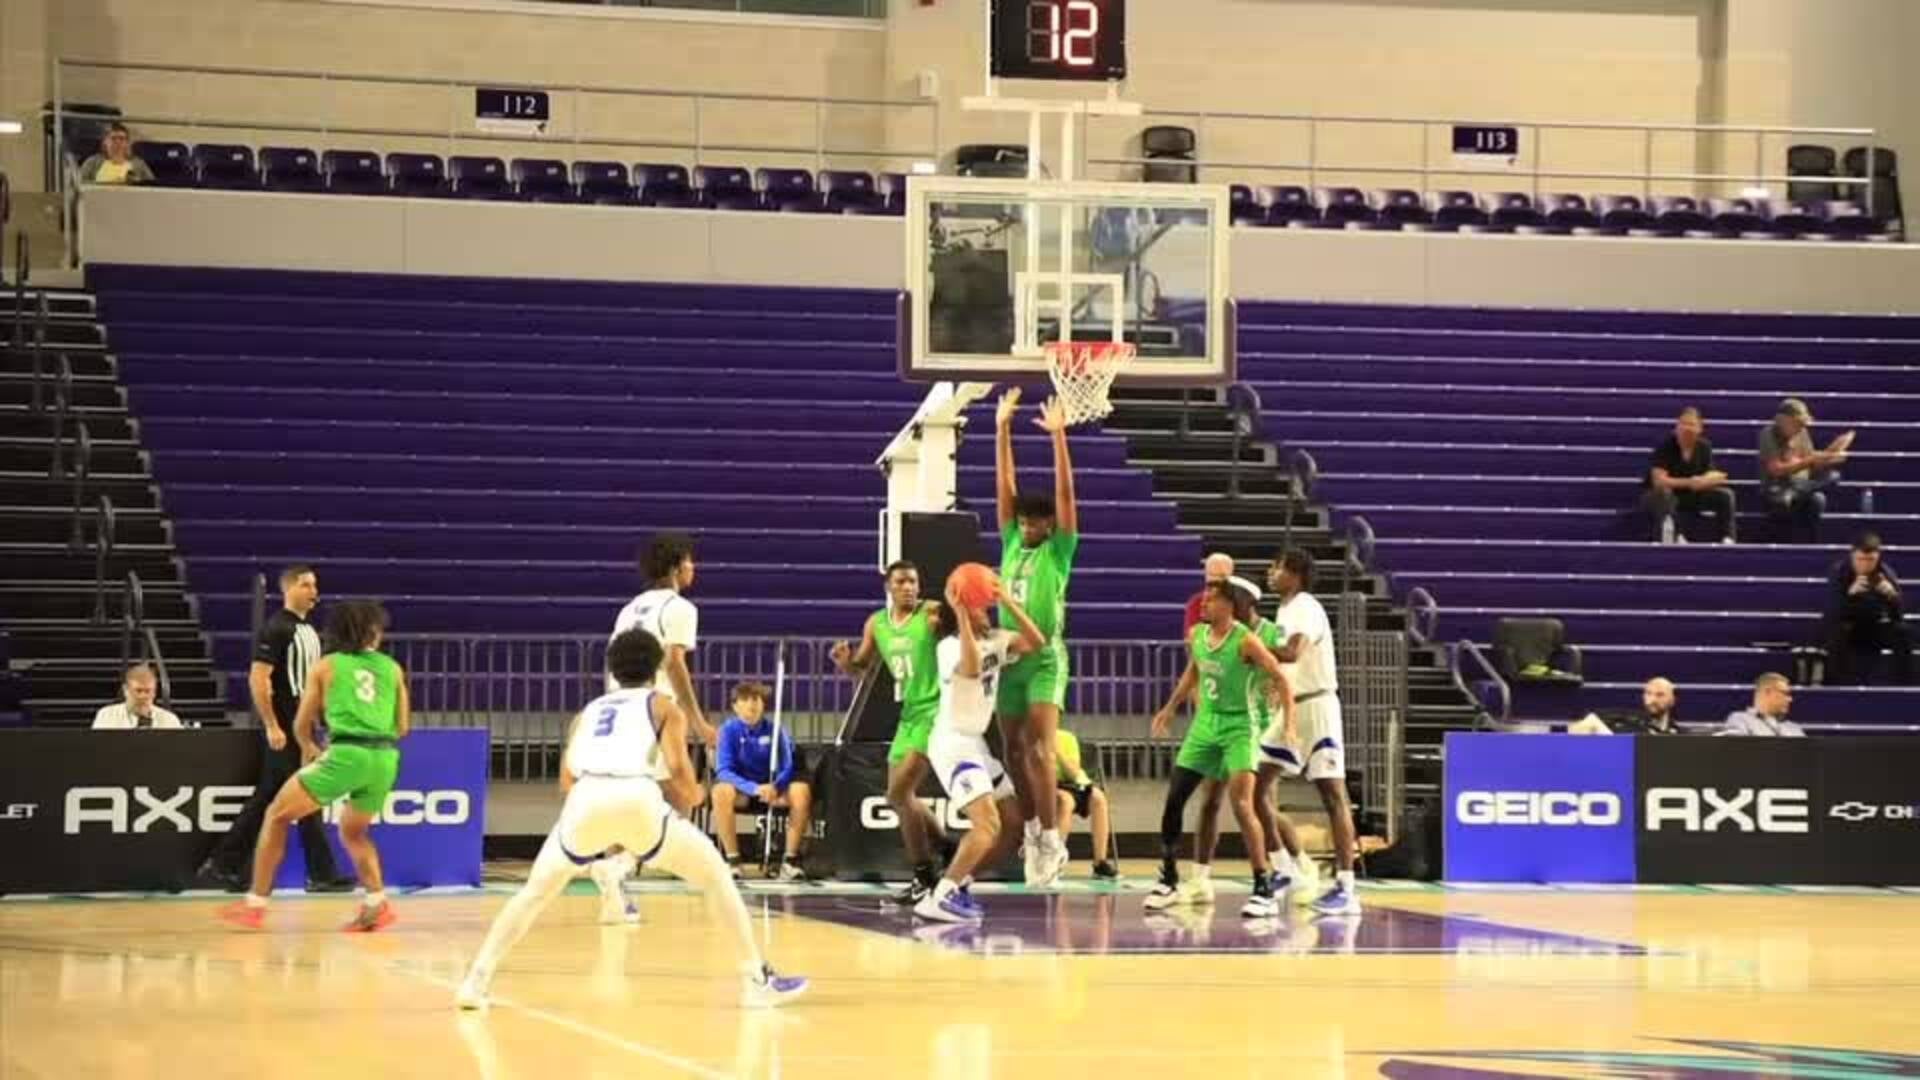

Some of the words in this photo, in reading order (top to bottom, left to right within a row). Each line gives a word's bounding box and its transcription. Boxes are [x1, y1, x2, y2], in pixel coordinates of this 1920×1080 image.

[1051, 1, 1098, 65] 12
[504, 95, 536, 115] 112
[1477, 131, 1507, 150] 113
[891, 653, 914, 680] 21
[353, 669, 376, 704] 3
[1204, 677, 1219, 701] 2
[594, 706, 618, 737] 3
[64, 785, 257, 834] AXE
[1456, 790, 1621, 826] GEICO
[1646, 787, 1809, 833] AXE
